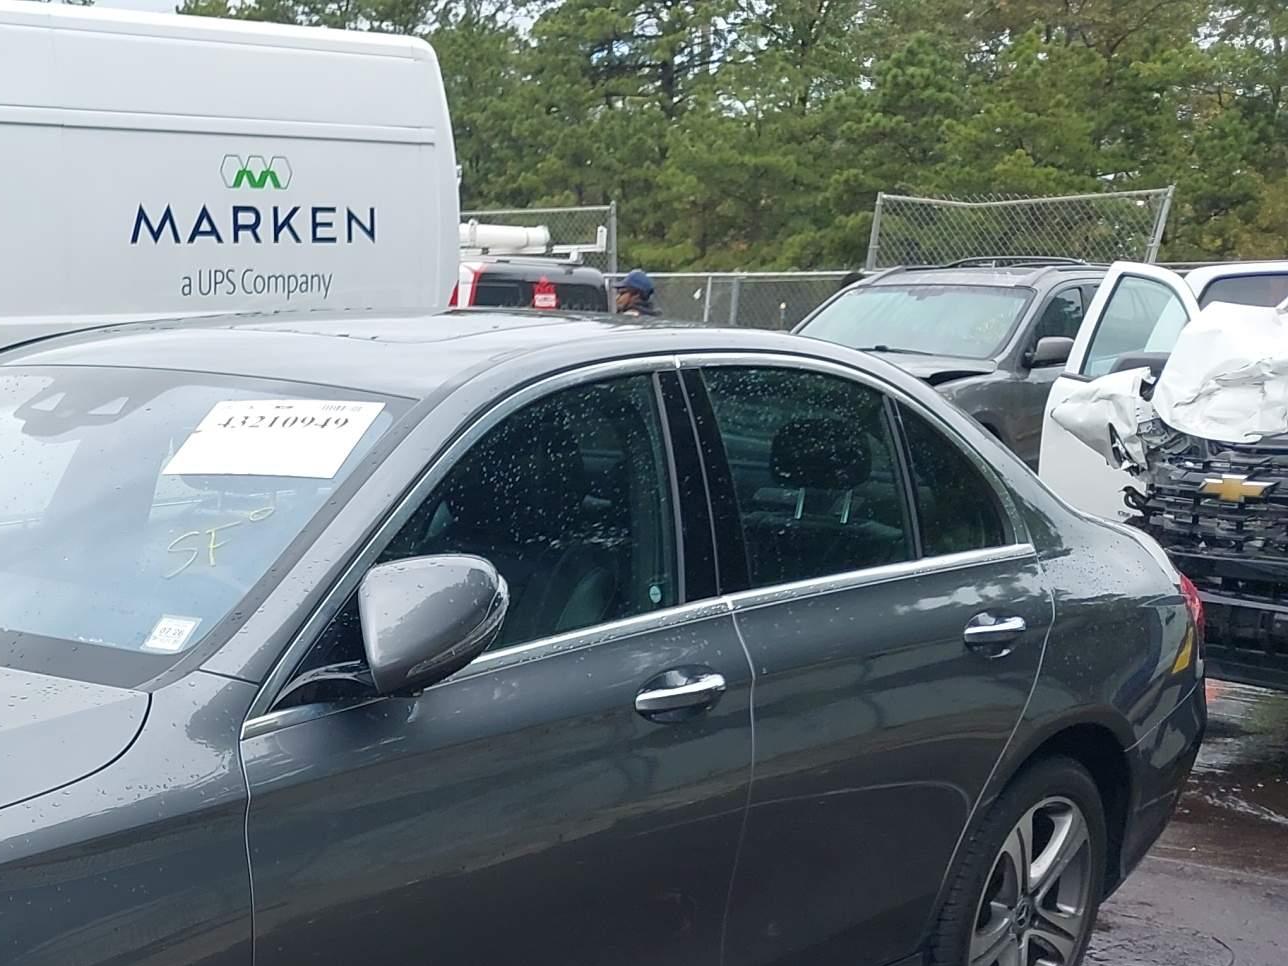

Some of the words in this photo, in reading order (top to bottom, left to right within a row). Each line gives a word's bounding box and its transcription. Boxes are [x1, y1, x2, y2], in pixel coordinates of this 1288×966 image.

[130, 203, 376, 244] MARKEN
[181, 275, 192, 296] a
[198, 269, 236, 296] UPS
[241, 268, 333, 300] Company
[217, 415, 350, 429] 43210949
